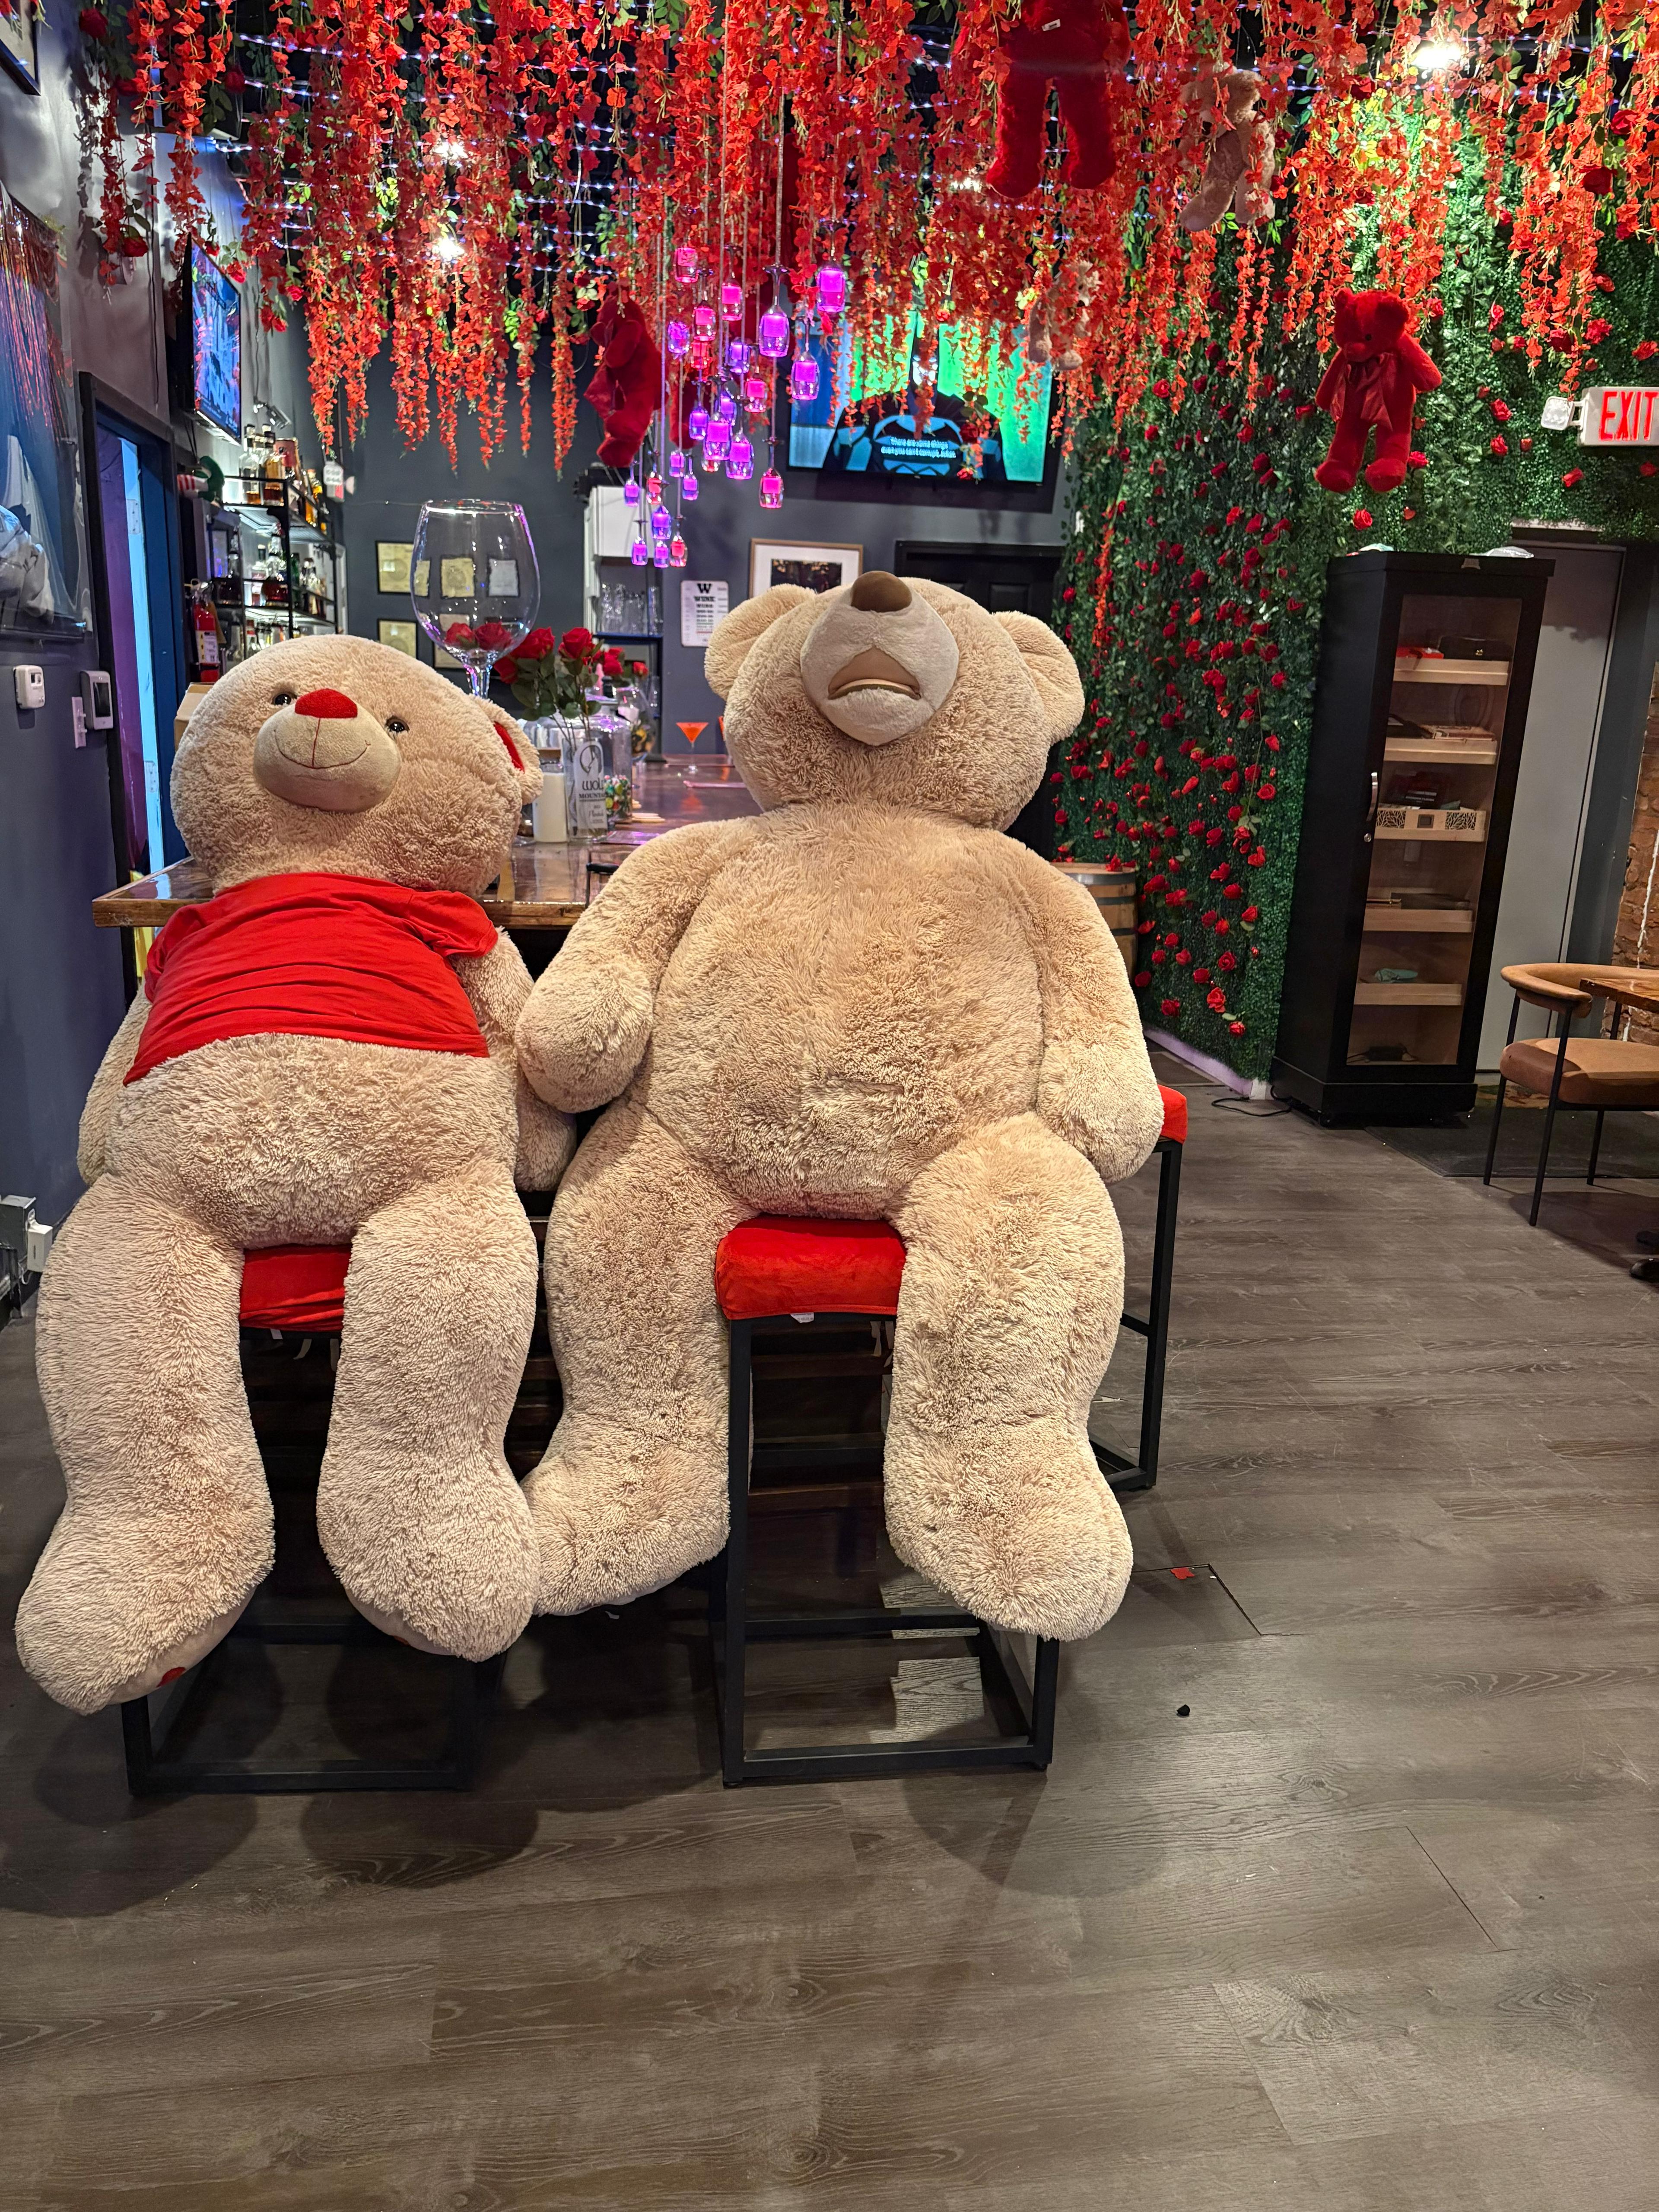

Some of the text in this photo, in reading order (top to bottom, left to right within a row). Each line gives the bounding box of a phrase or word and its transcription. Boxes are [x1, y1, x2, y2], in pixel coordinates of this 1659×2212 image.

[1599, 391, 1659, 441] EXIT
[931, 440, 948, 450] things
[895, 447, 906, 456] you
[697, 583, 712, 594] W
